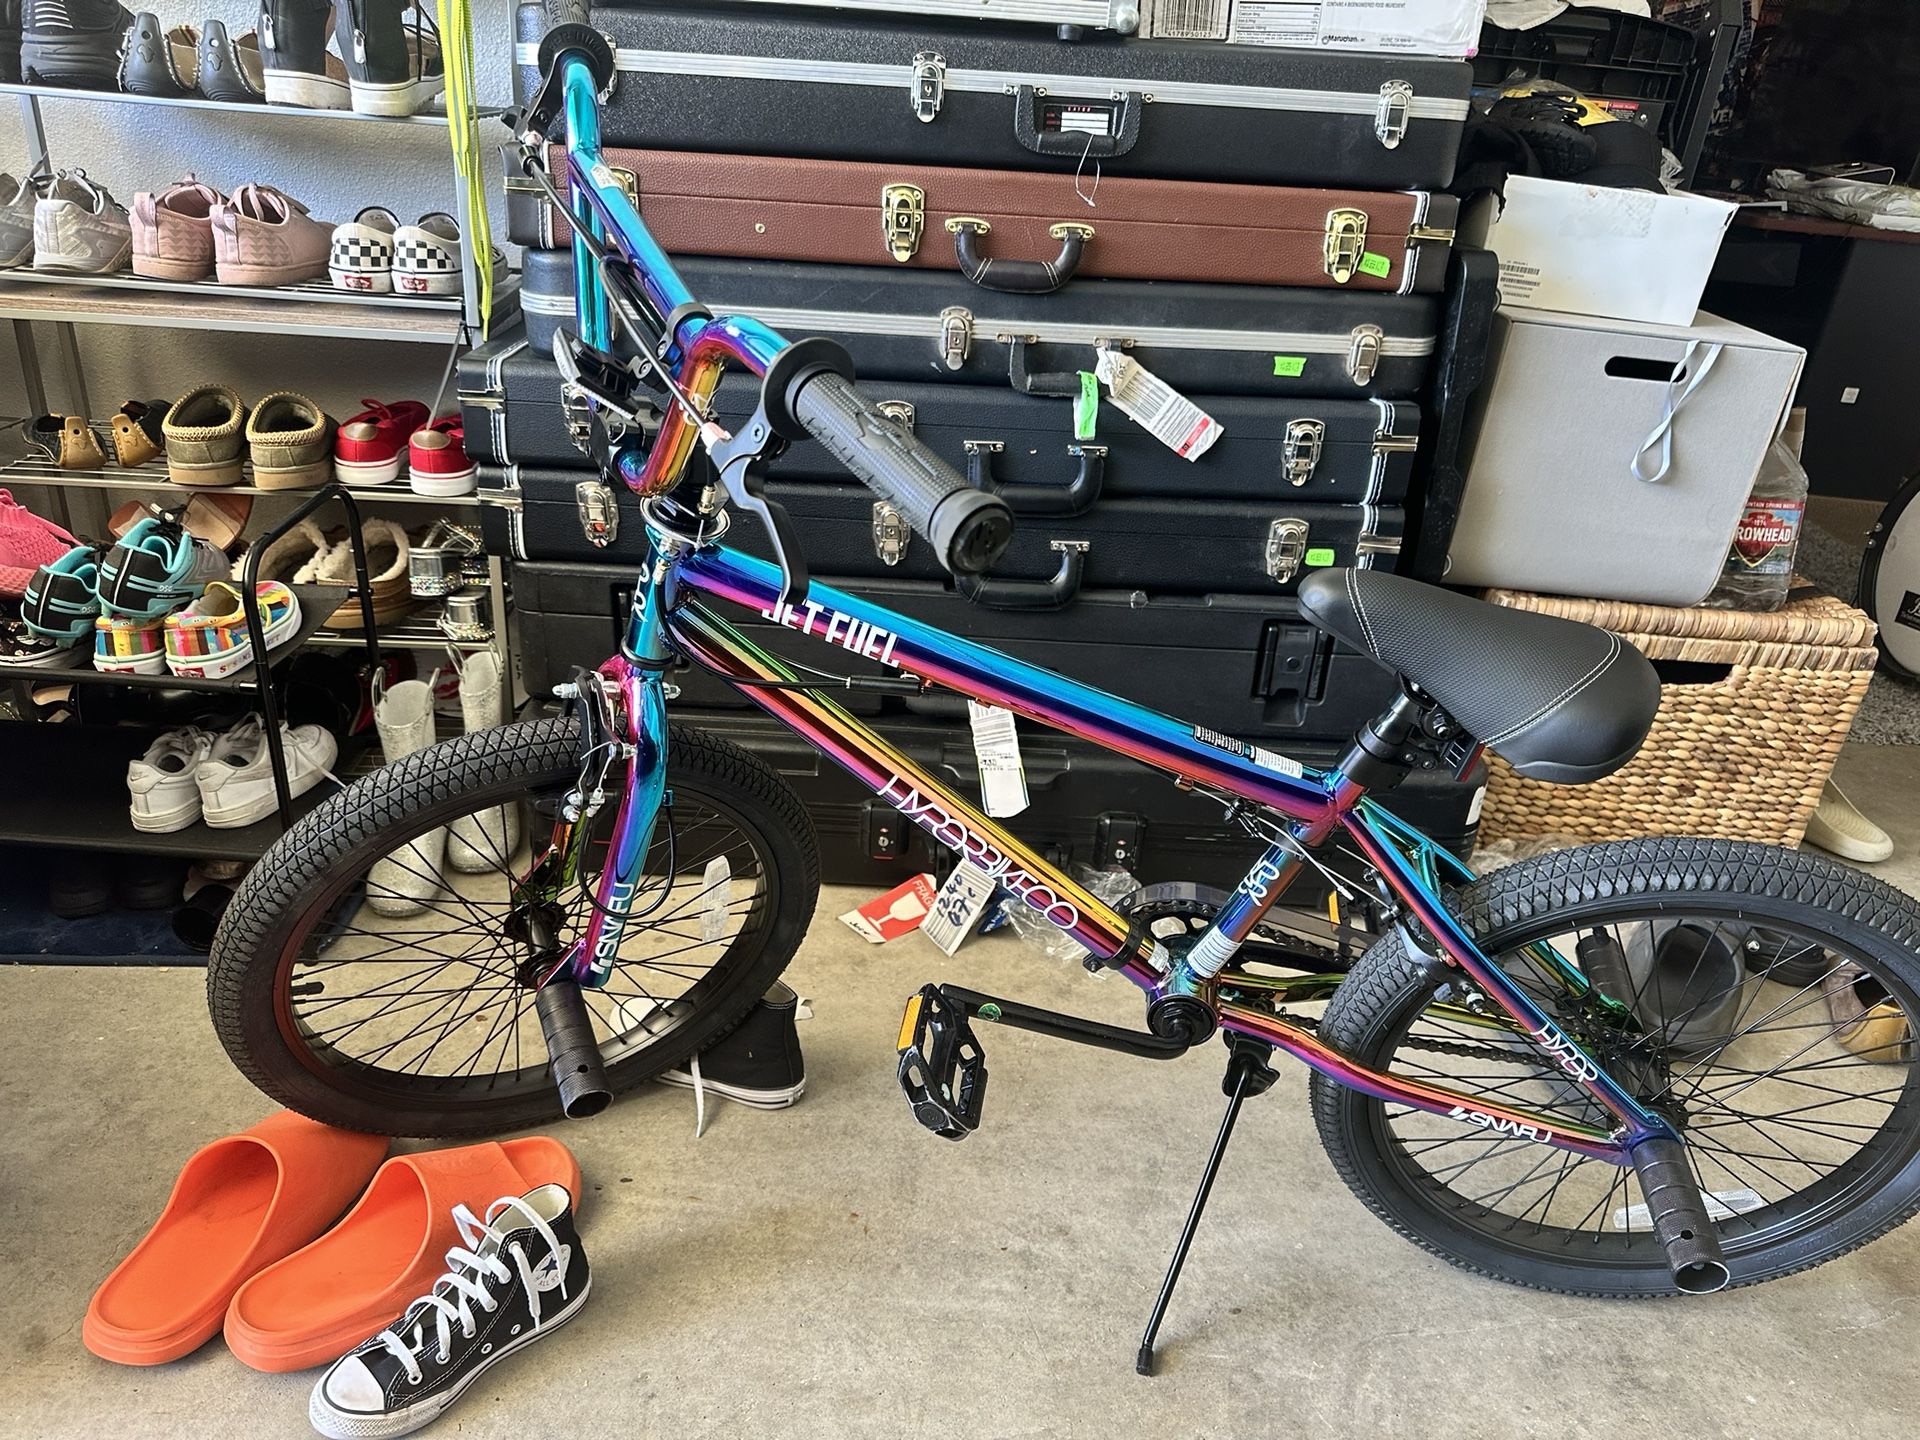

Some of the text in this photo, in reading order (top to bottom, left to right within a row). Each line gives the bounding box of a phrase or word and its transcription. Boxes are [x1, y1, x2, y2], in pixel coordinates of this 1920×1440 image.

[761, 592, 900, 669] JET FUEL
[1468, 1112, 1553, 1144] SNAFU
